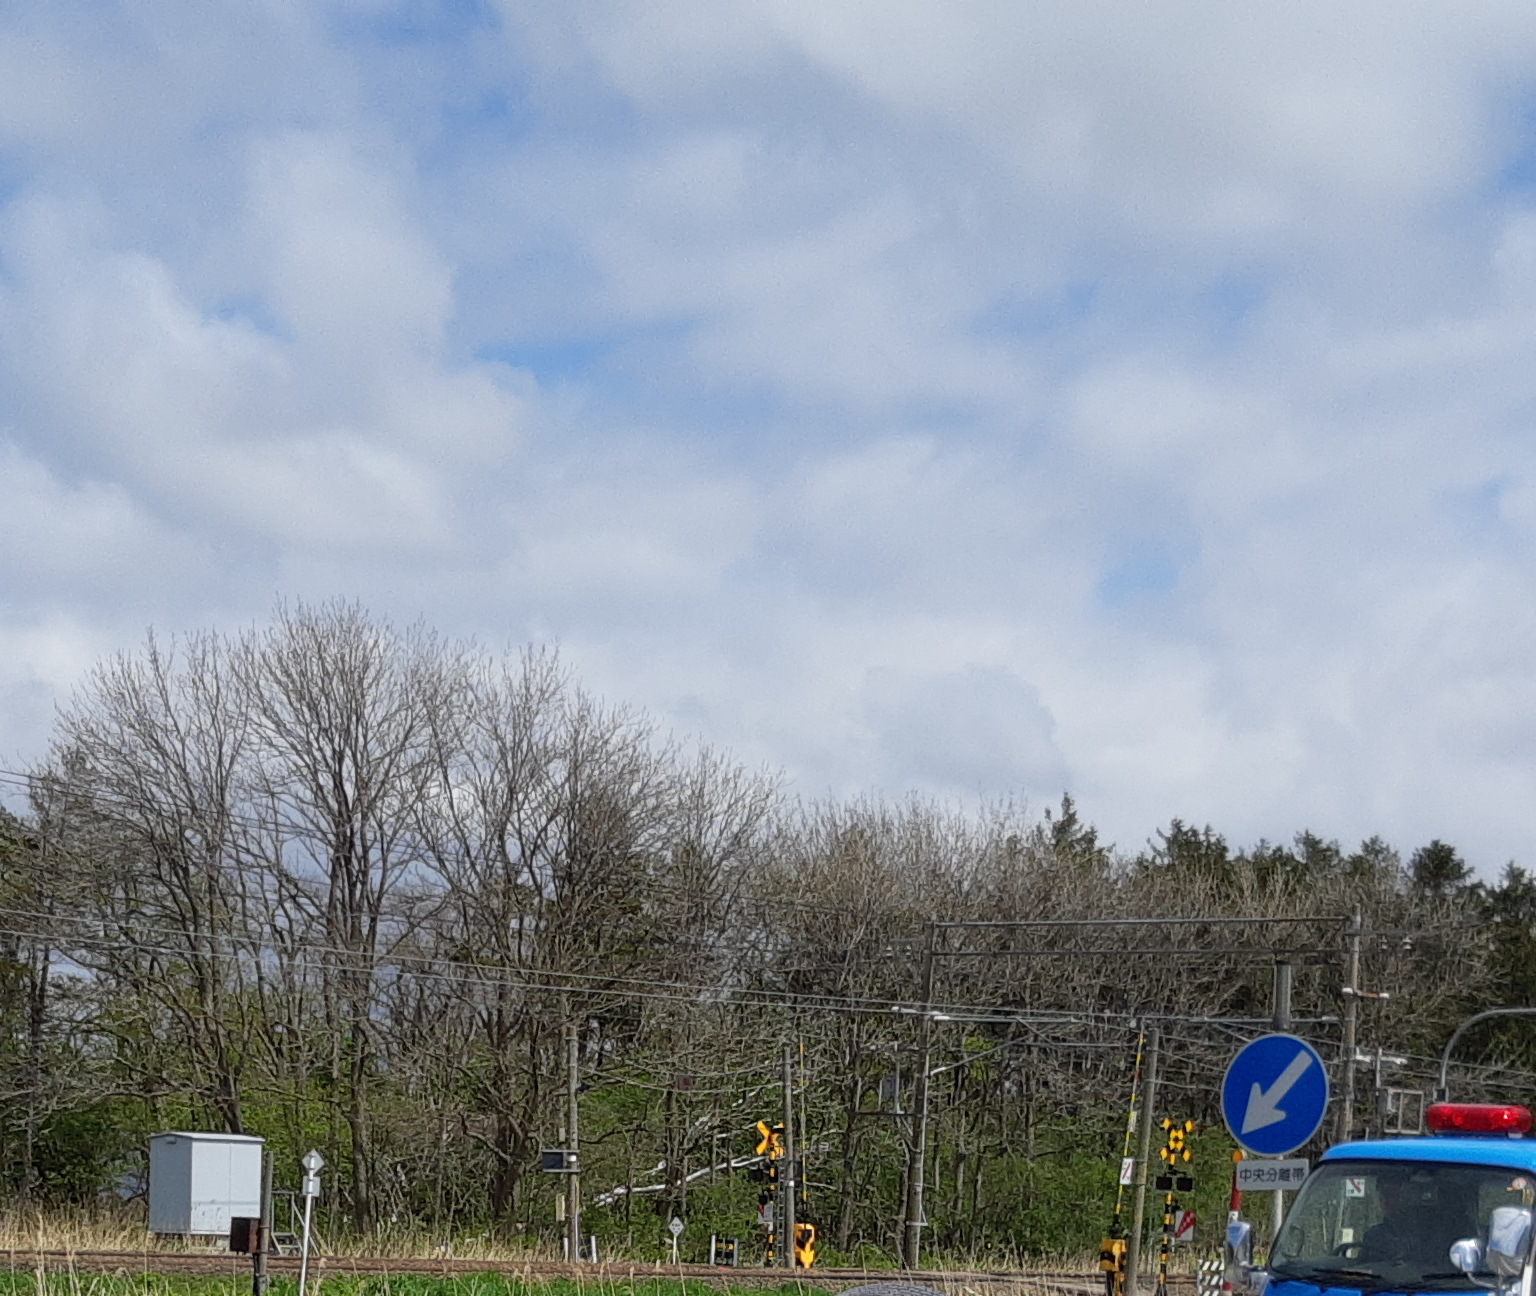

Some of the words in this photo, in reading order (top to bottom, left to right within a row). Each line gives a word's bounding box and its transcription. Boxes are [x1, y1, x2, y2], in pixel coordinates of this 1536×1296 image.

[1239, 1167, 1305, 1183] 中央分離帯
